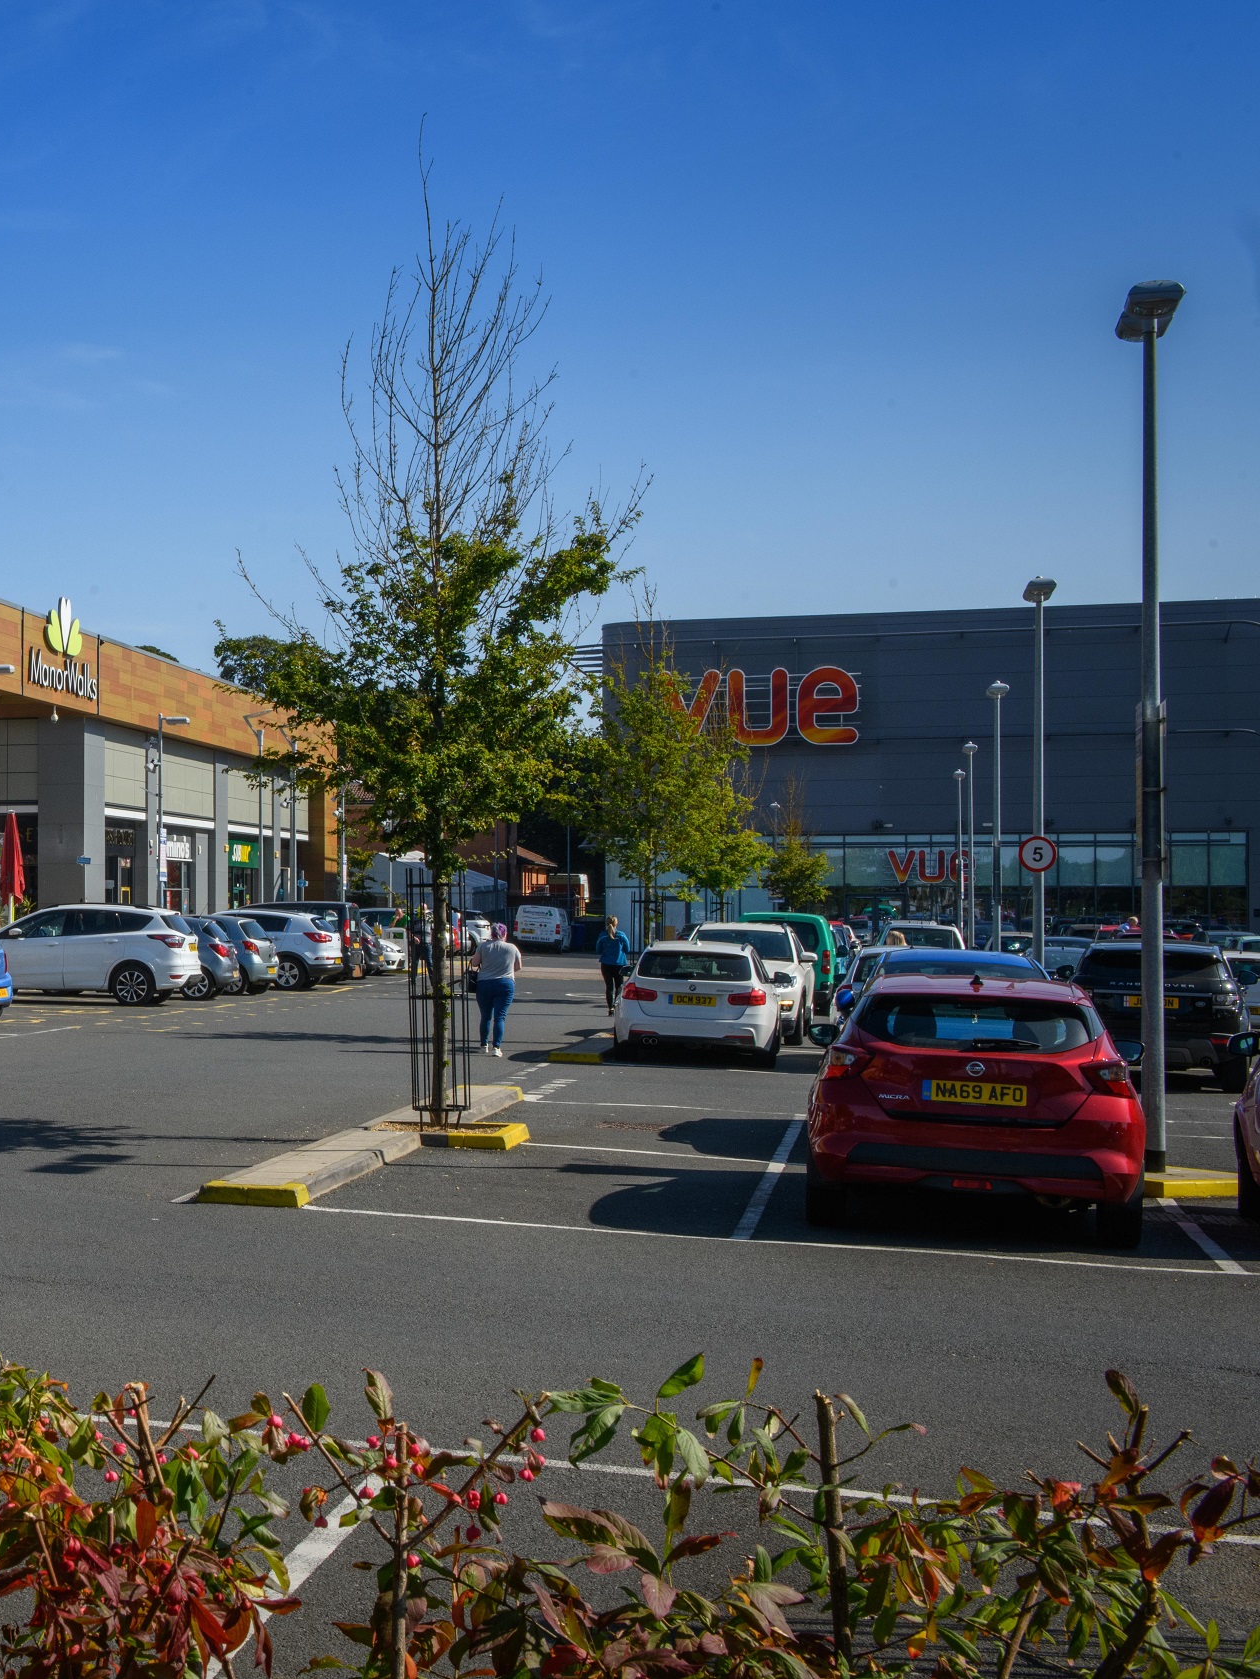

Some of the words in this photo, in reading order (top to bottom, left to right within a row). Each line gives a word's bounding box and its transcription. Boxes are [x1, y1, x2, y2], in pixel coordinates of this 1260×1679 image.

[167, 840, 190, 859] mino's
[1032, 847, 1044, 863] 5
[695, 995, 713, 1005] 937
[935, 1082, 983, 1099] NA69
